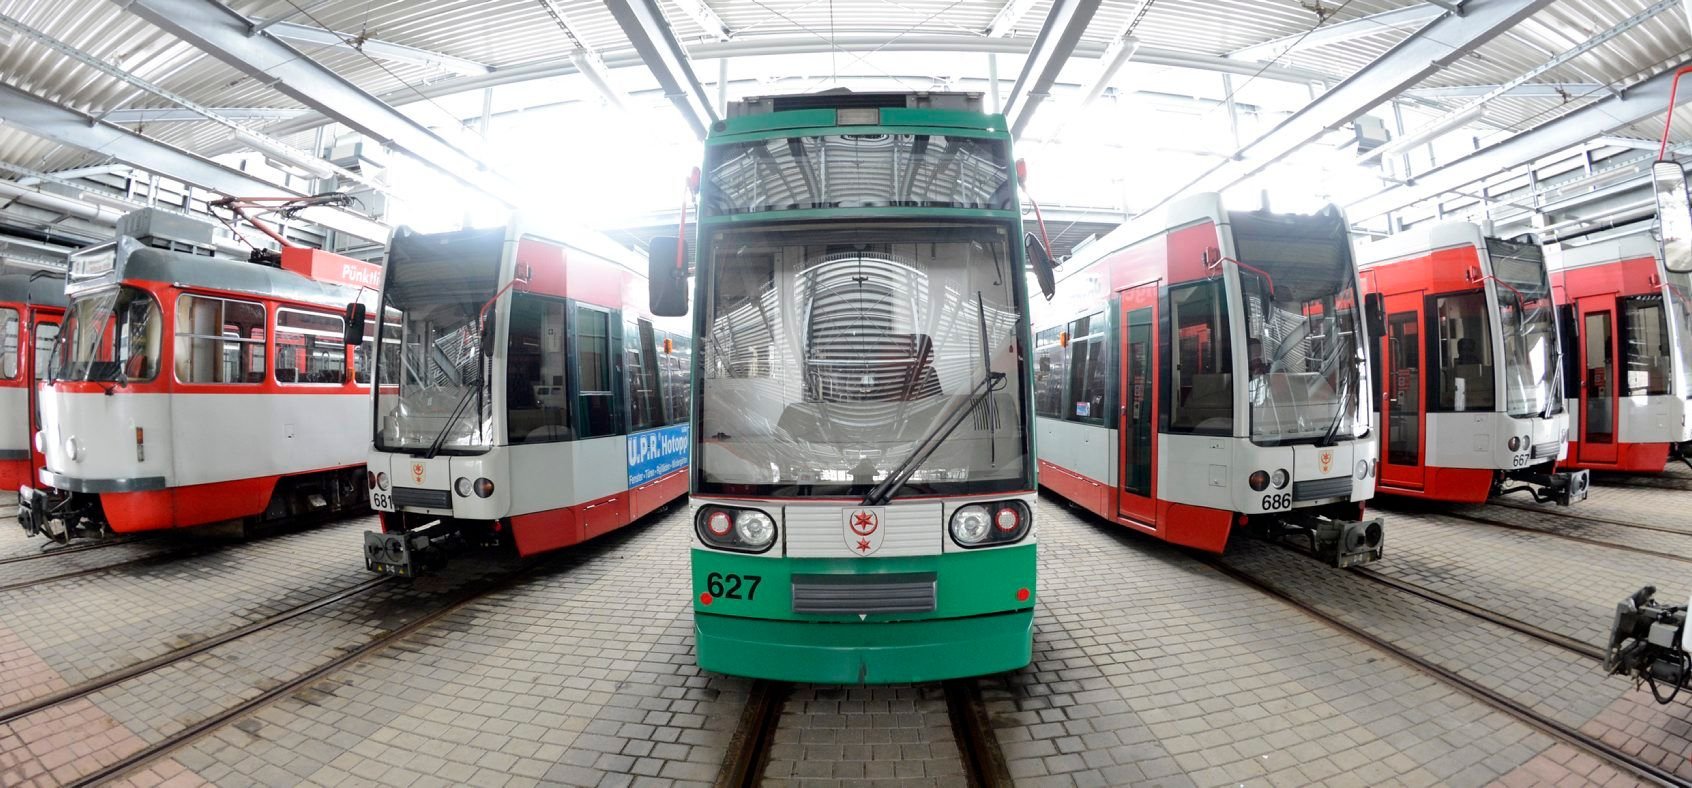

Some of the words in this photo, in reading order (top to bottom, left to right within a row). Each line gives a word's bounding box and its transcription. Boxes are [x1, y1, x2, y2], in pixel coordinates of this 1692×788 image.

[661, 434, 688, 456] Hotopp
[1513, 453, 1530, 467] 667
[373, 493, 393, 509] 681
[1261, 492, 1292, 511] 686
[707, 572, 762, 601] 627
